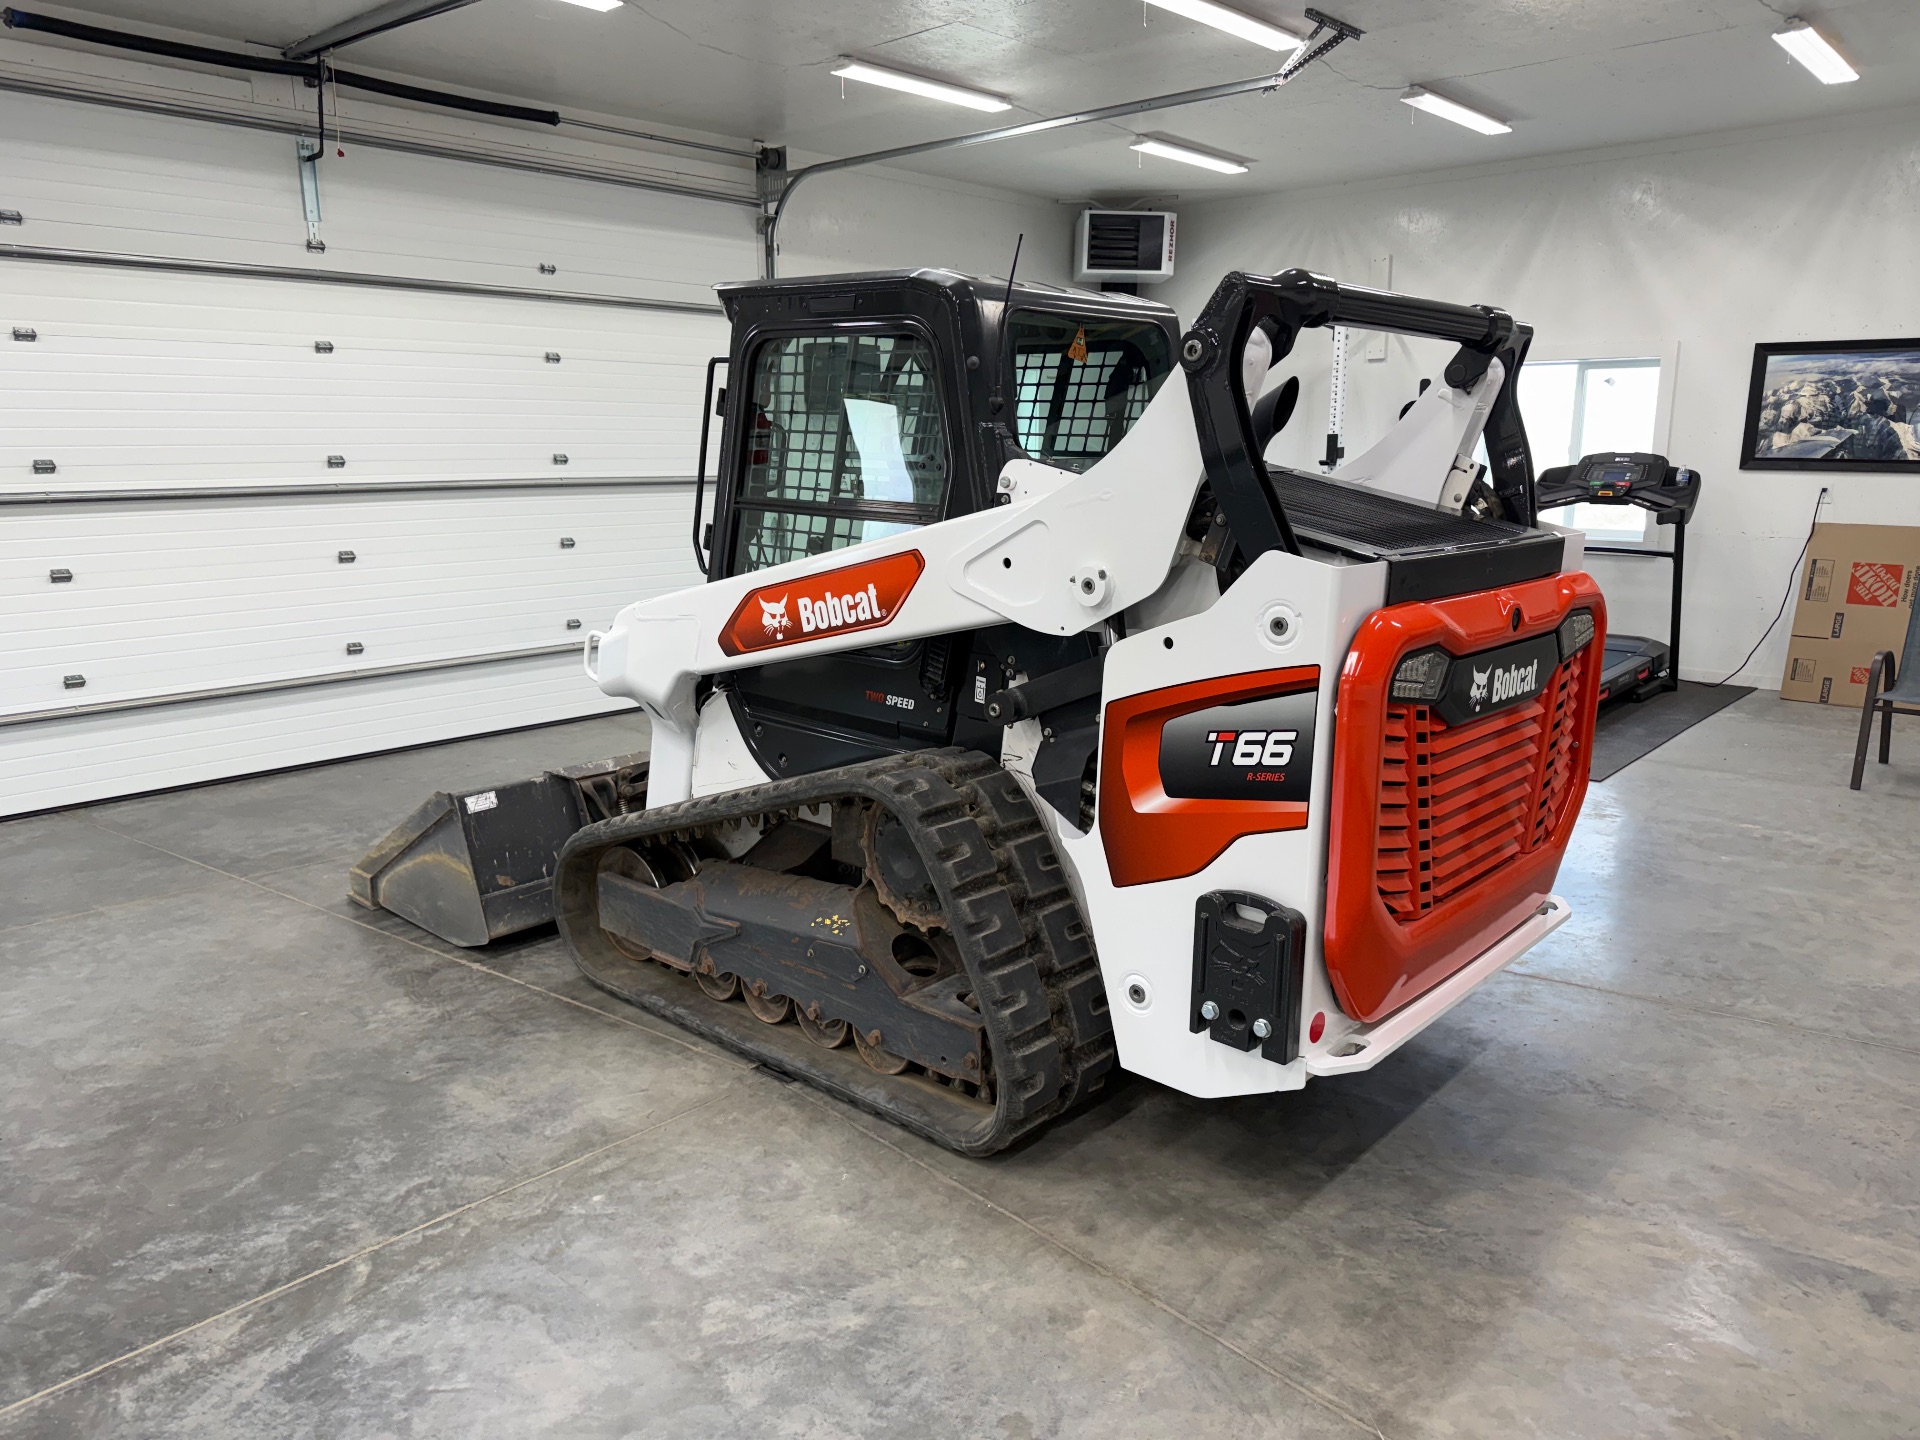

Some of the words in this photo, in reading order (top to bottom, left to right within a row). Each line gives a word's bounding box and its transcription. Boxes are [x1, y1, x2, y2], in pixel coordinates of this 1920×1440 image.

[1851, 562, 1898, 607] HOME
[1870, 564, 1901, 591] DEPOT
[1904, 570, 1913, 587] doers
[1853, 582, 1873, 602] THE
[1901, 588, 1909, 603] How
[797, 583, 881, 633] Bobcat
[1833, 614, 1843, 637] LARGE
[1491, 658, 1538, 703] Bobcat
[1821, 679, 1831, 702] LARGE
[865, 690, 885, 704] TWO
[885, 694, 915, 710] SPEED
[1206, 730, 1298, 767] T66
[1246, 772, 1286, 782] R-SERIES
